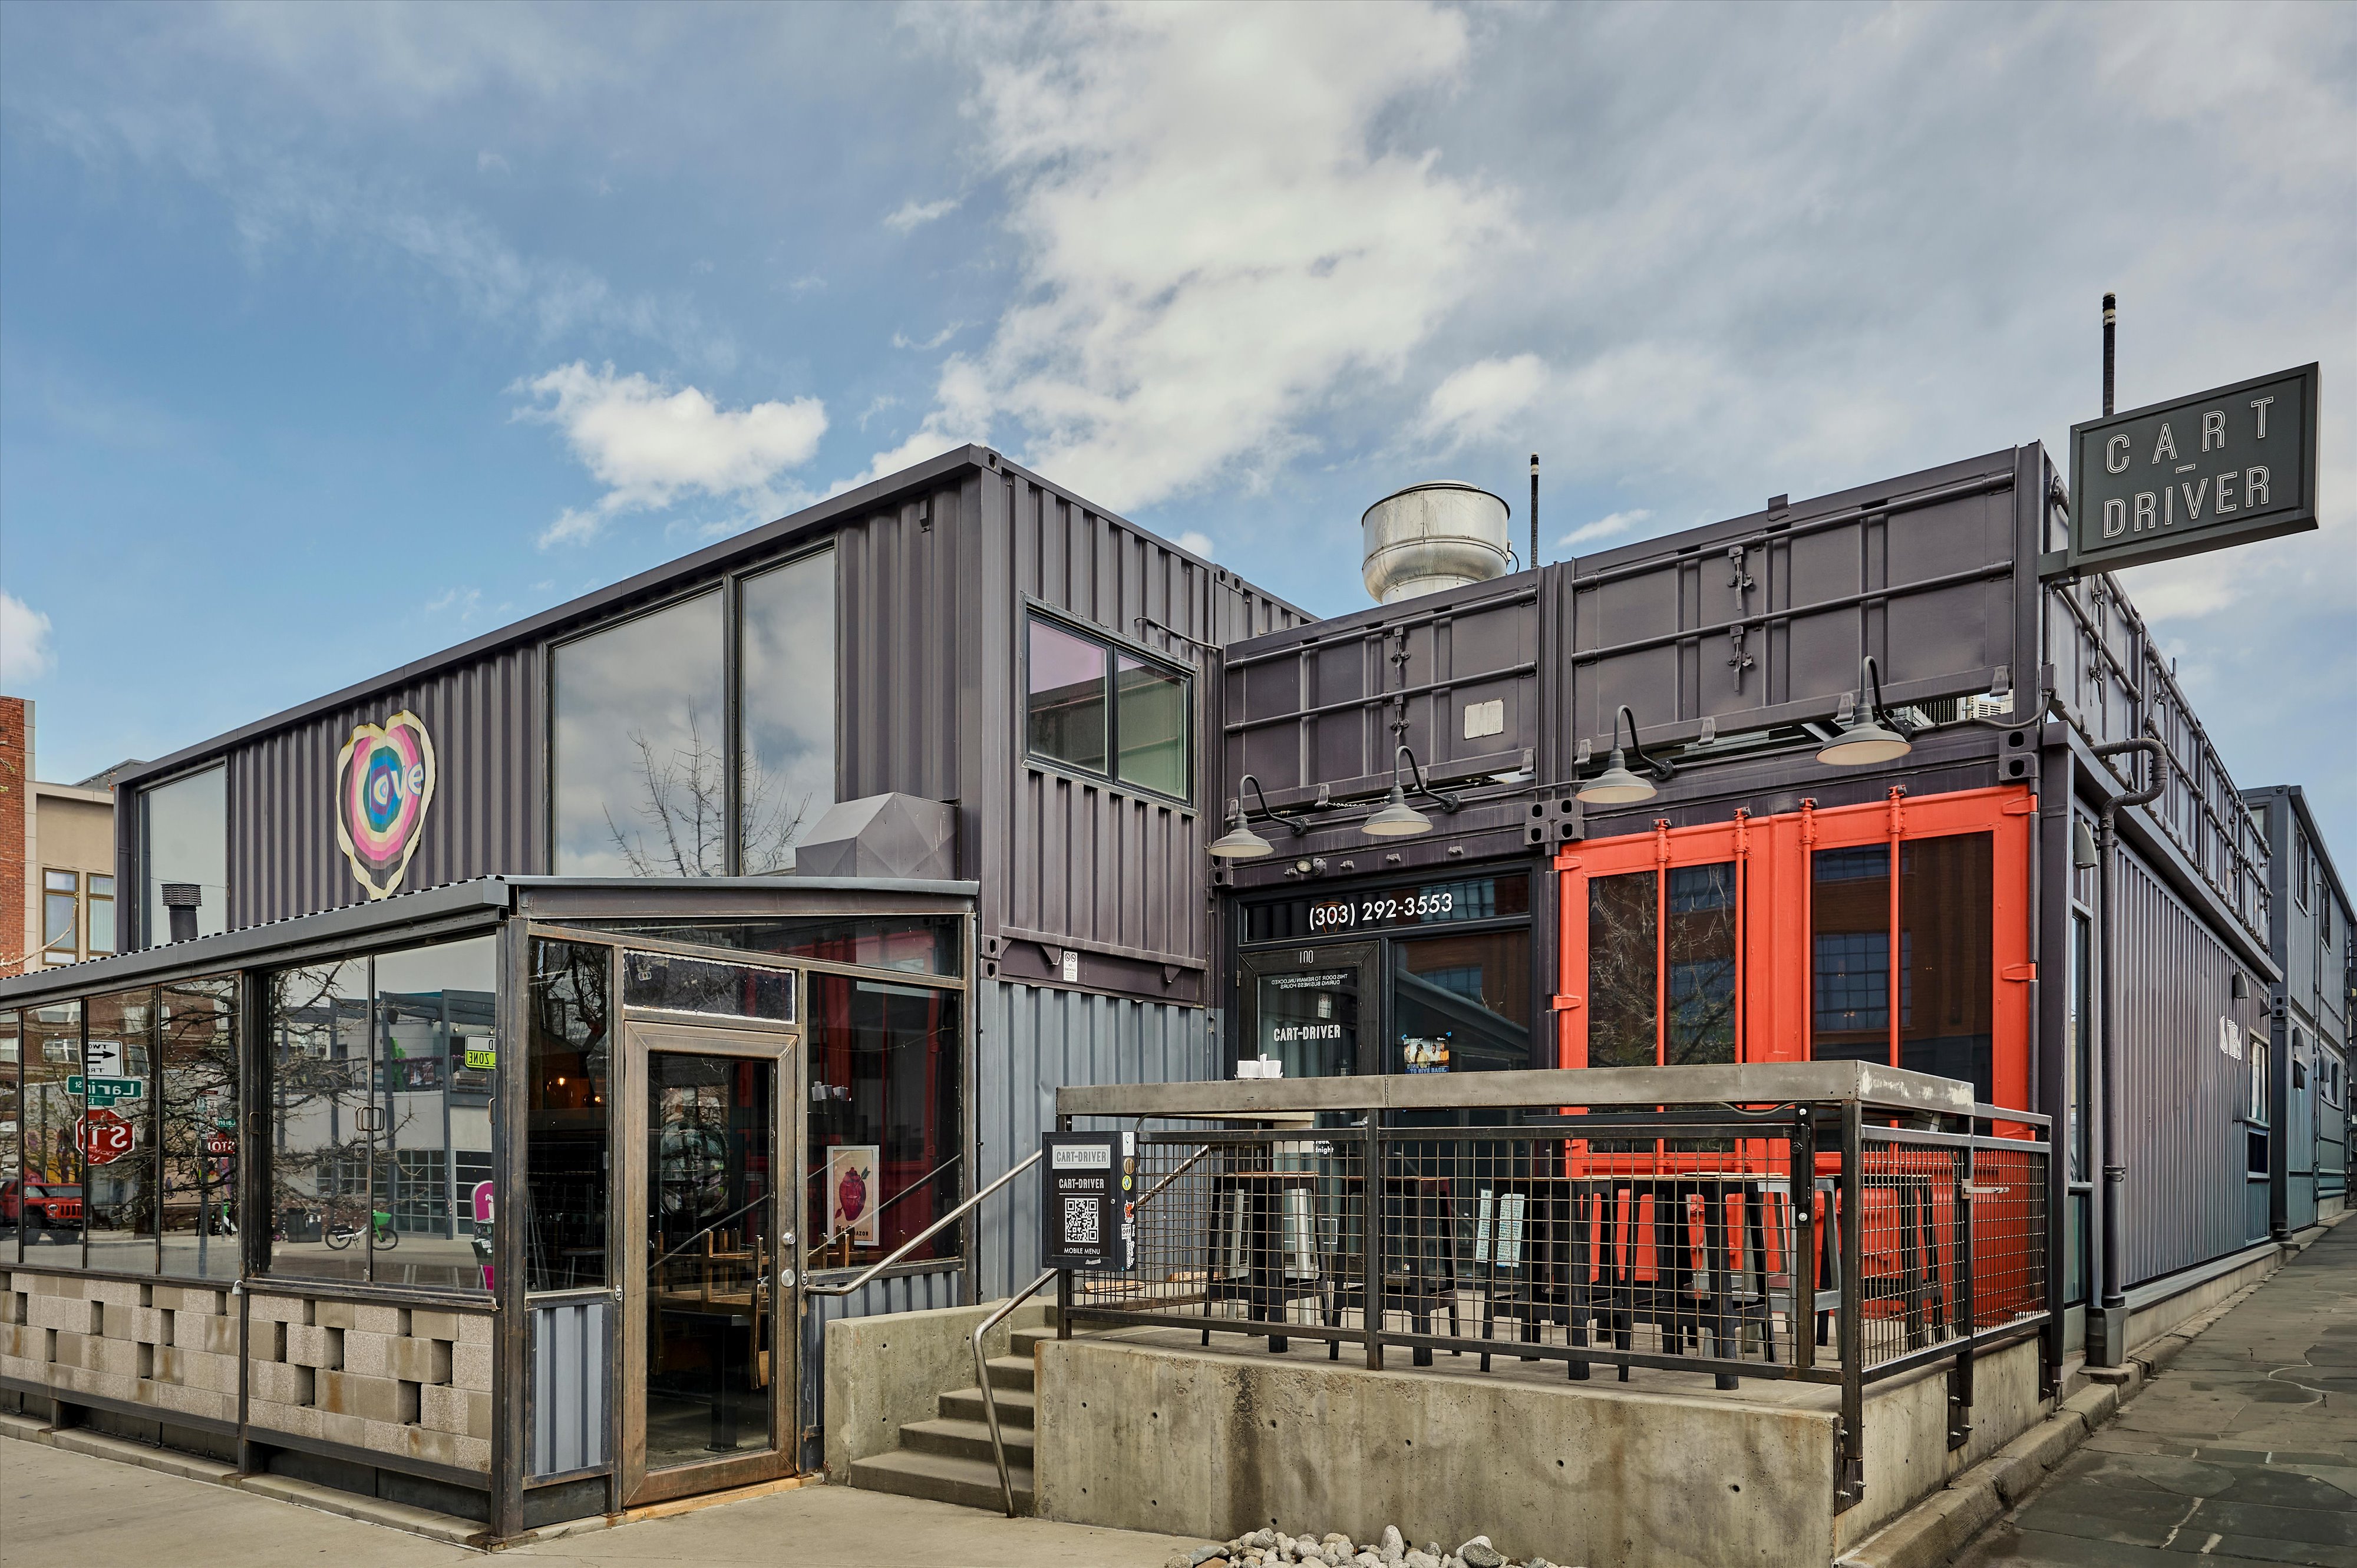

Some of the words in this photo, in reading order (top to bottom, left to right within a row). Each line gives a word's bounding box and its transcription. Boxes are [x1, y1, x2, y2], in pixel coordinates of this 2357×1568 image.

[2105, 396, 2274, 474] CART
[2103, 466, 2270, 539] DRIVER
[1309, 902, 1355, 930] (303)
[1362, 893, 1453, 921] 292-3553
[1273, 1024, 1341, 1042] CART-DRIVER
[1056, 1151, 1107, 1163] CART-DRIVER
[1315, 1146, 1334, 1154] dnight
[1058, 1178, 1104, 1189] CART-DRIVER
